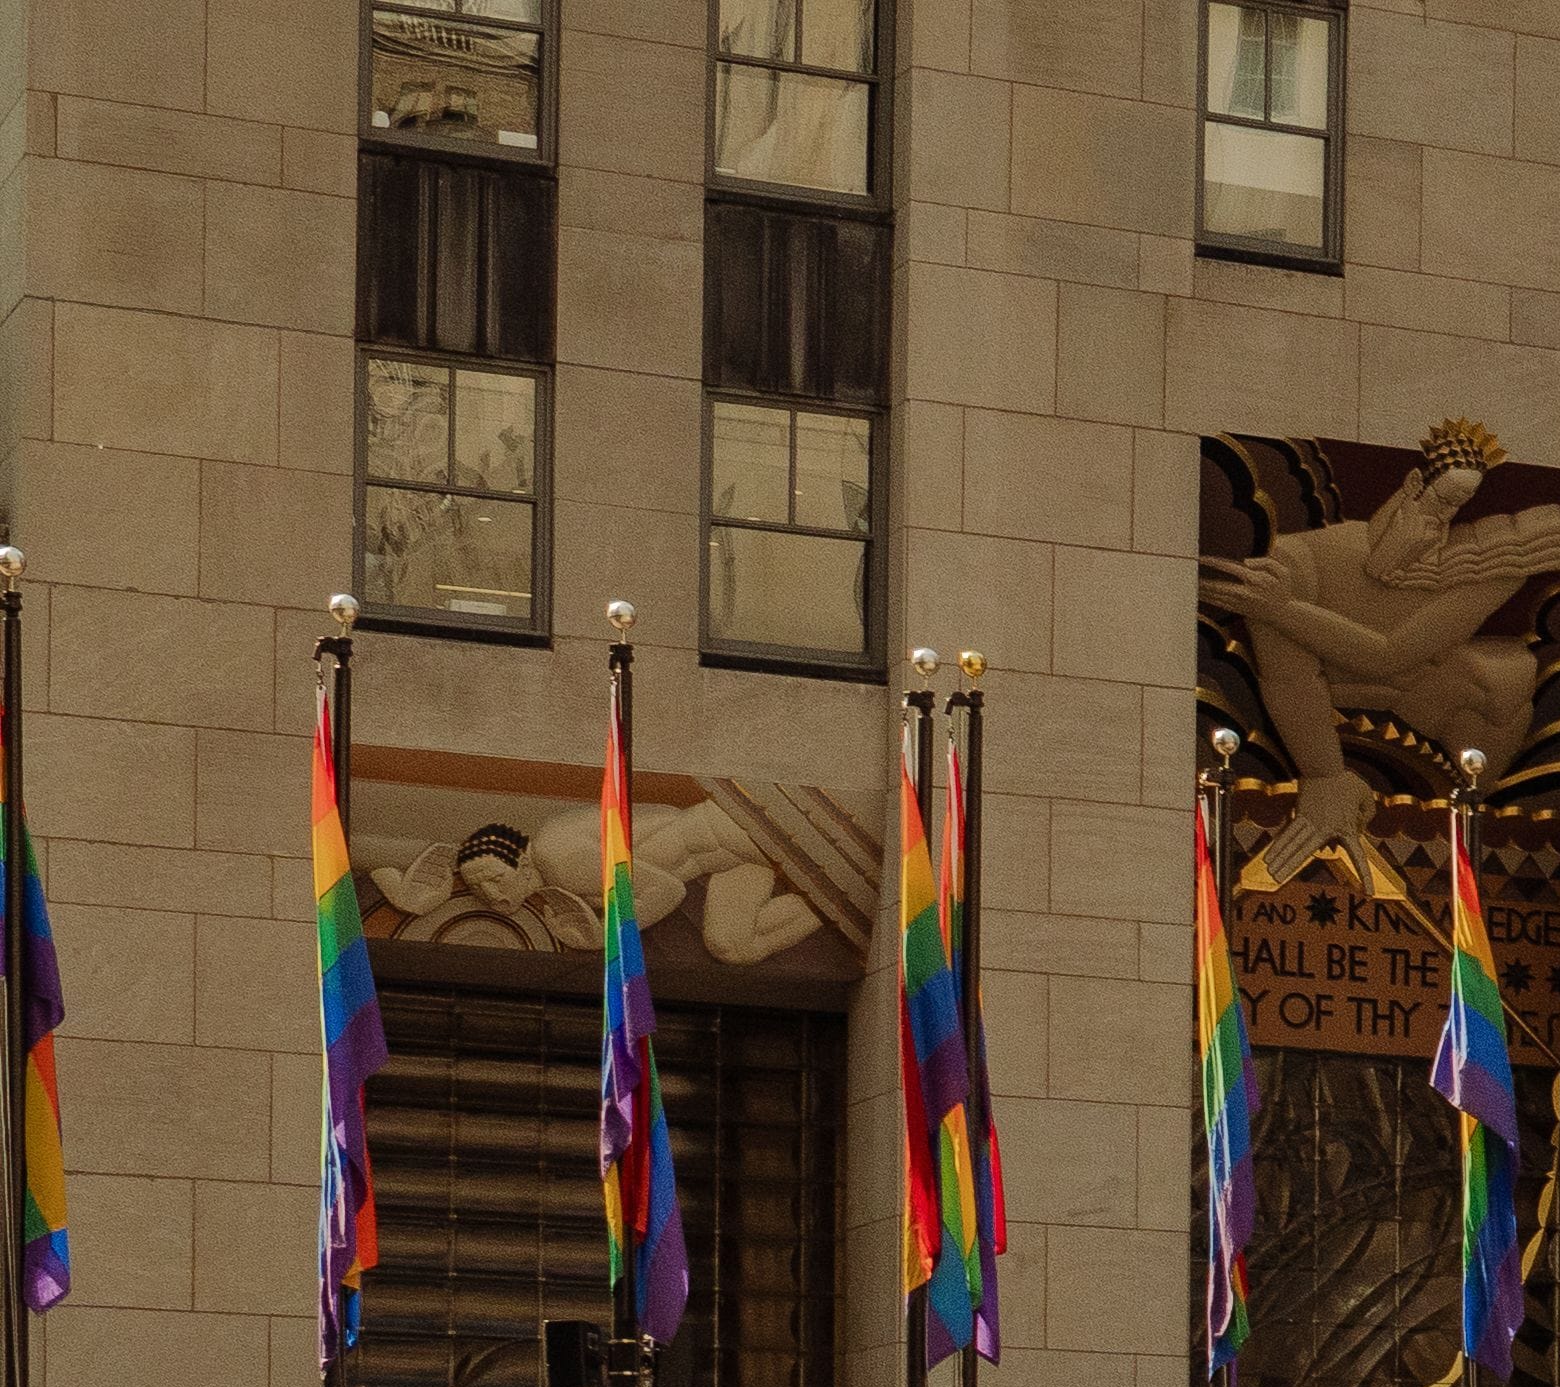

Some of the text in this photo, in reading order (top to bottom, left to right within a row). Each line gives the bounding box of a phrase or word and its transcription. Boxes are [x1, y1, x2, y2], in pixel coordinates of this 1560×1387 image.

[1253, 902, 1297, 925] AND
[1231, 937, 1439, 988] HALL BE THE
[1279, 992, 1334, 1030] OF
[1346, 996, 1423, 1038] THY
